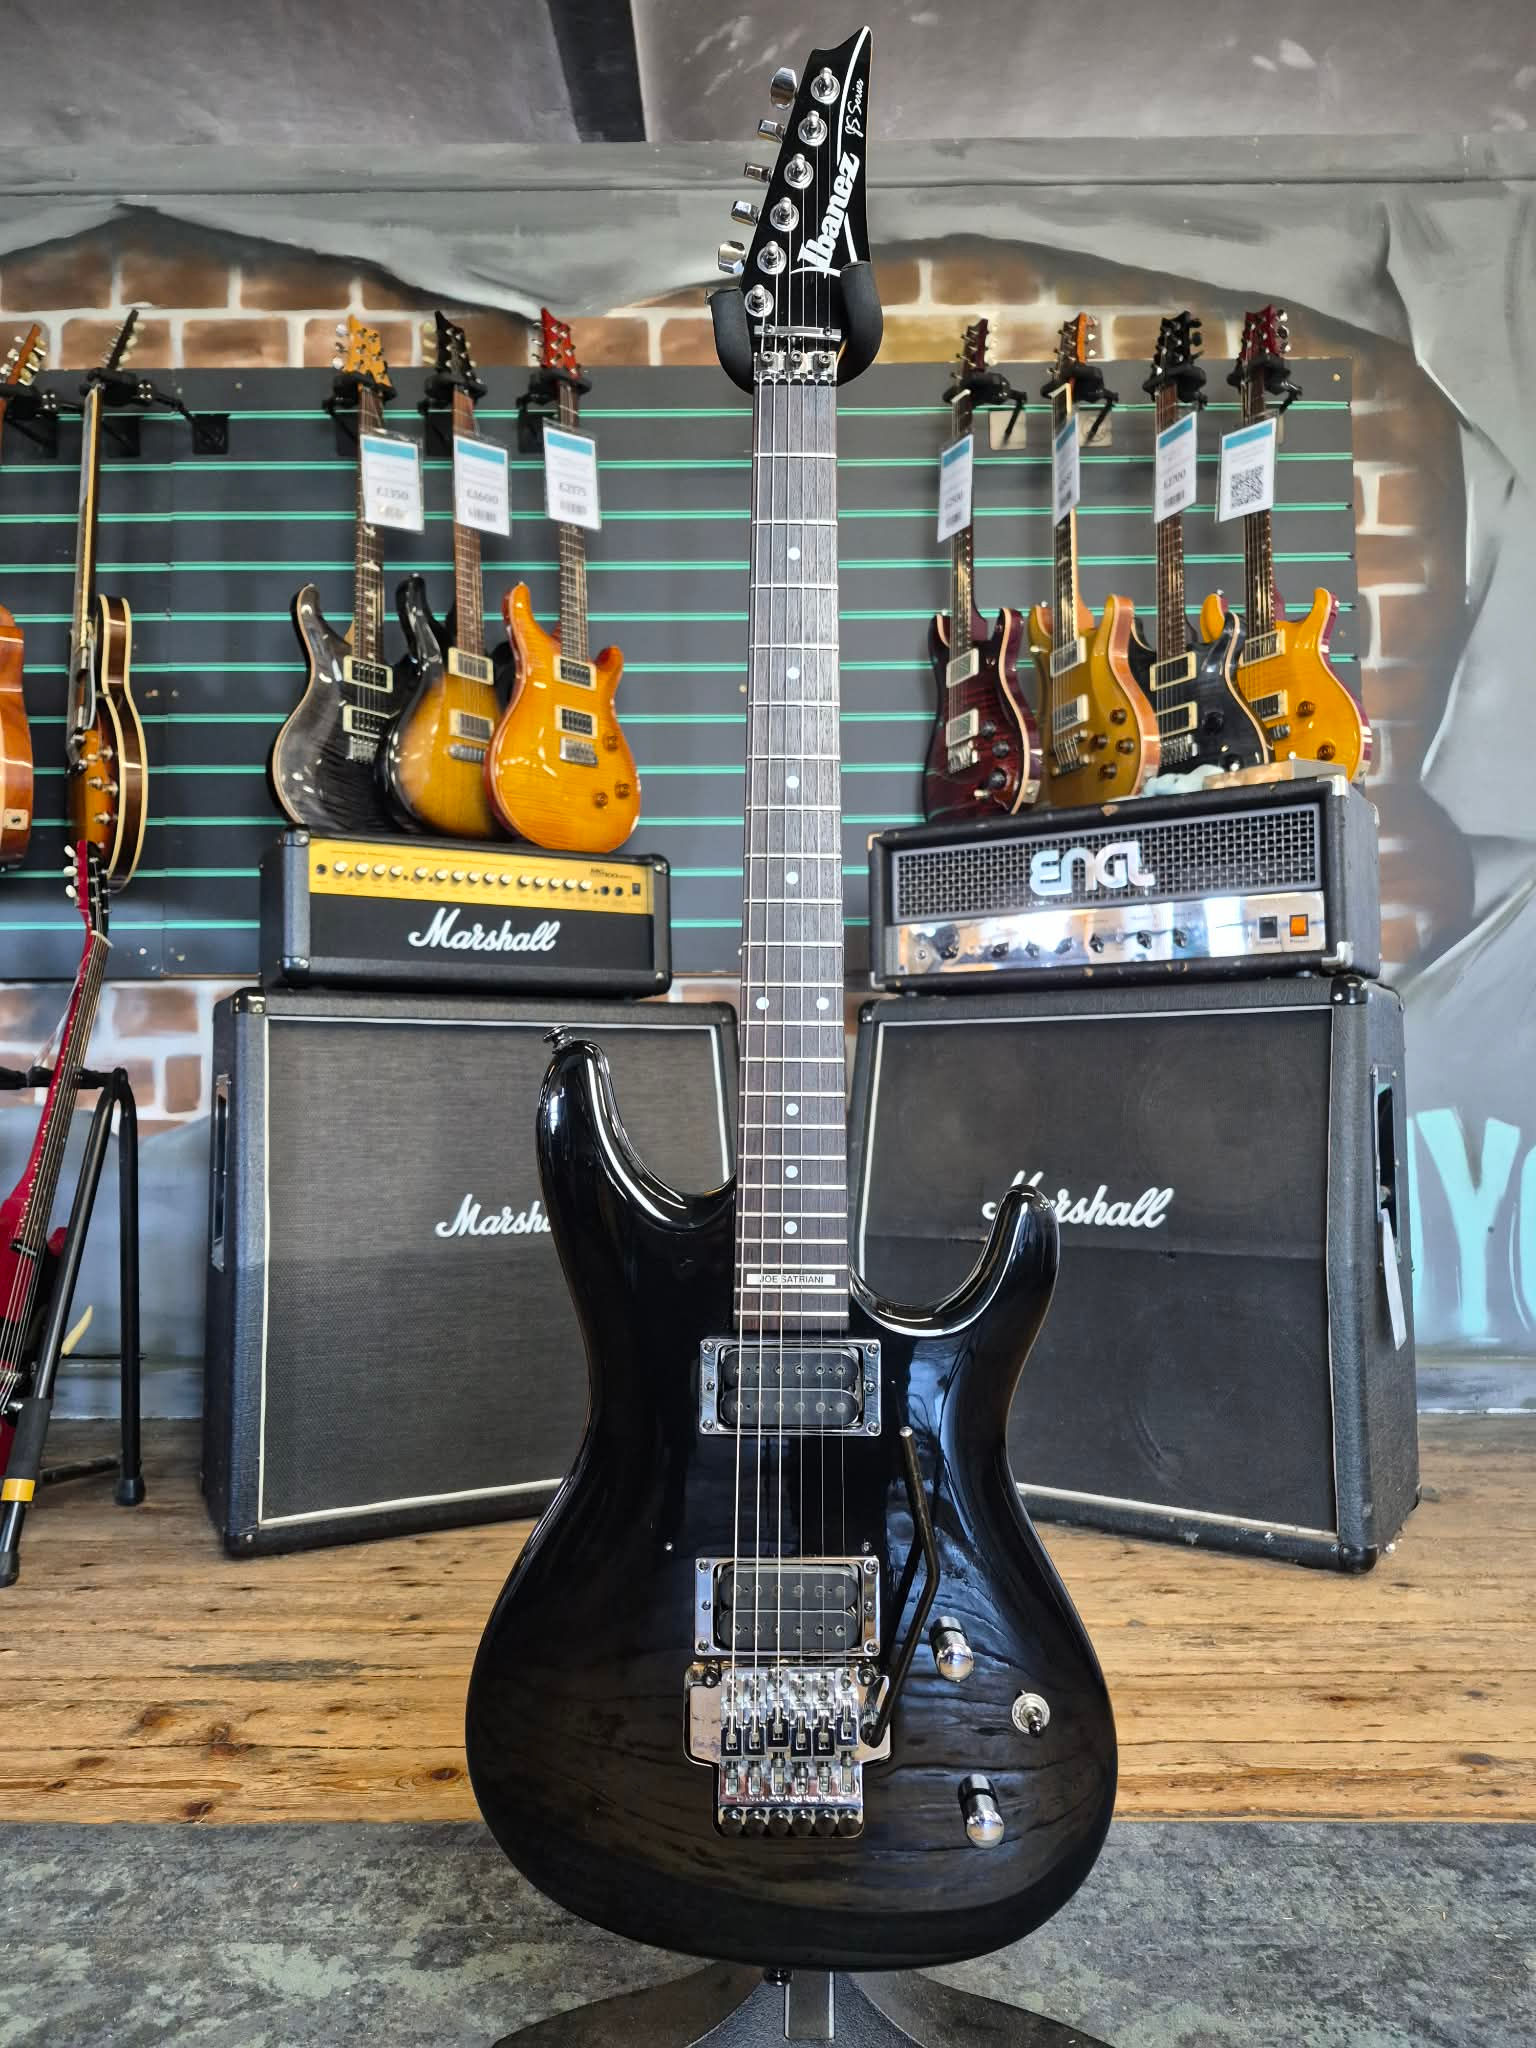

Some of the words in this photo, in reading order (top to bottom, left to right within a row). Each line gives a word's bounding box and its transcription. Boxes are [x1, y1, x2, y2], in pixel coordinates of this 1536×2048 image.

[847, 78, 864, 115] Series
[791, 151, 860, 279] Ibanez
[1029, 840, 1156, 896] ENGL
[407, 906, 561, 952] Marshall
[434, 1193, 550, 1238] Marsh
[760, 1275, 780, 1284] JOE
[781, 1275, 824, 1284] SATRIANI
